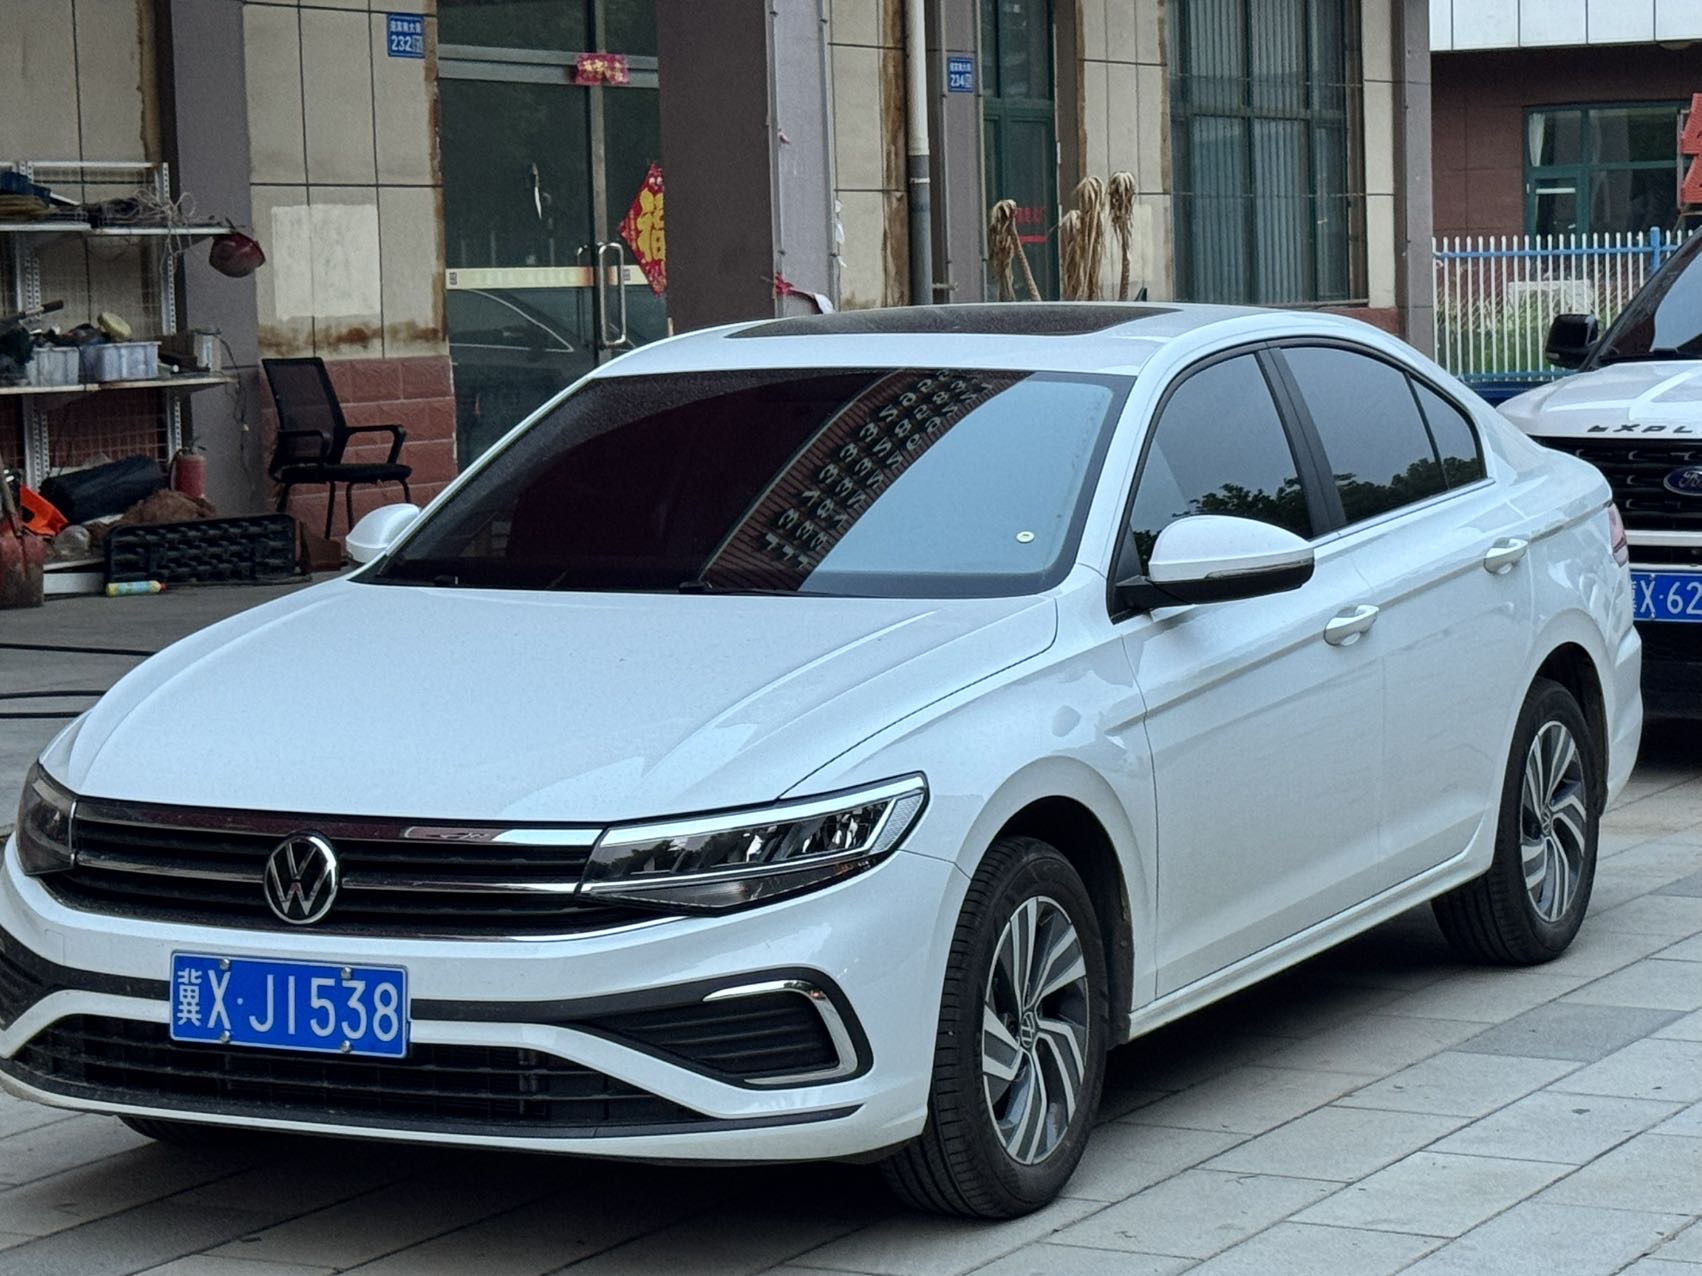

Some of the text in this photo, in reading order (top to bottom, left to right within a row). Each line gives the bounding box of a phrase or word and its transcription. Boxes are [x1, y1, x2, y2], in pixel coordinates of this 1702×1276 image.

[391, 35, 412, 51] 232
[1587, 424, 1702, 433] EXPL
[177, 968, 399, 1042] 冀X·J1538
